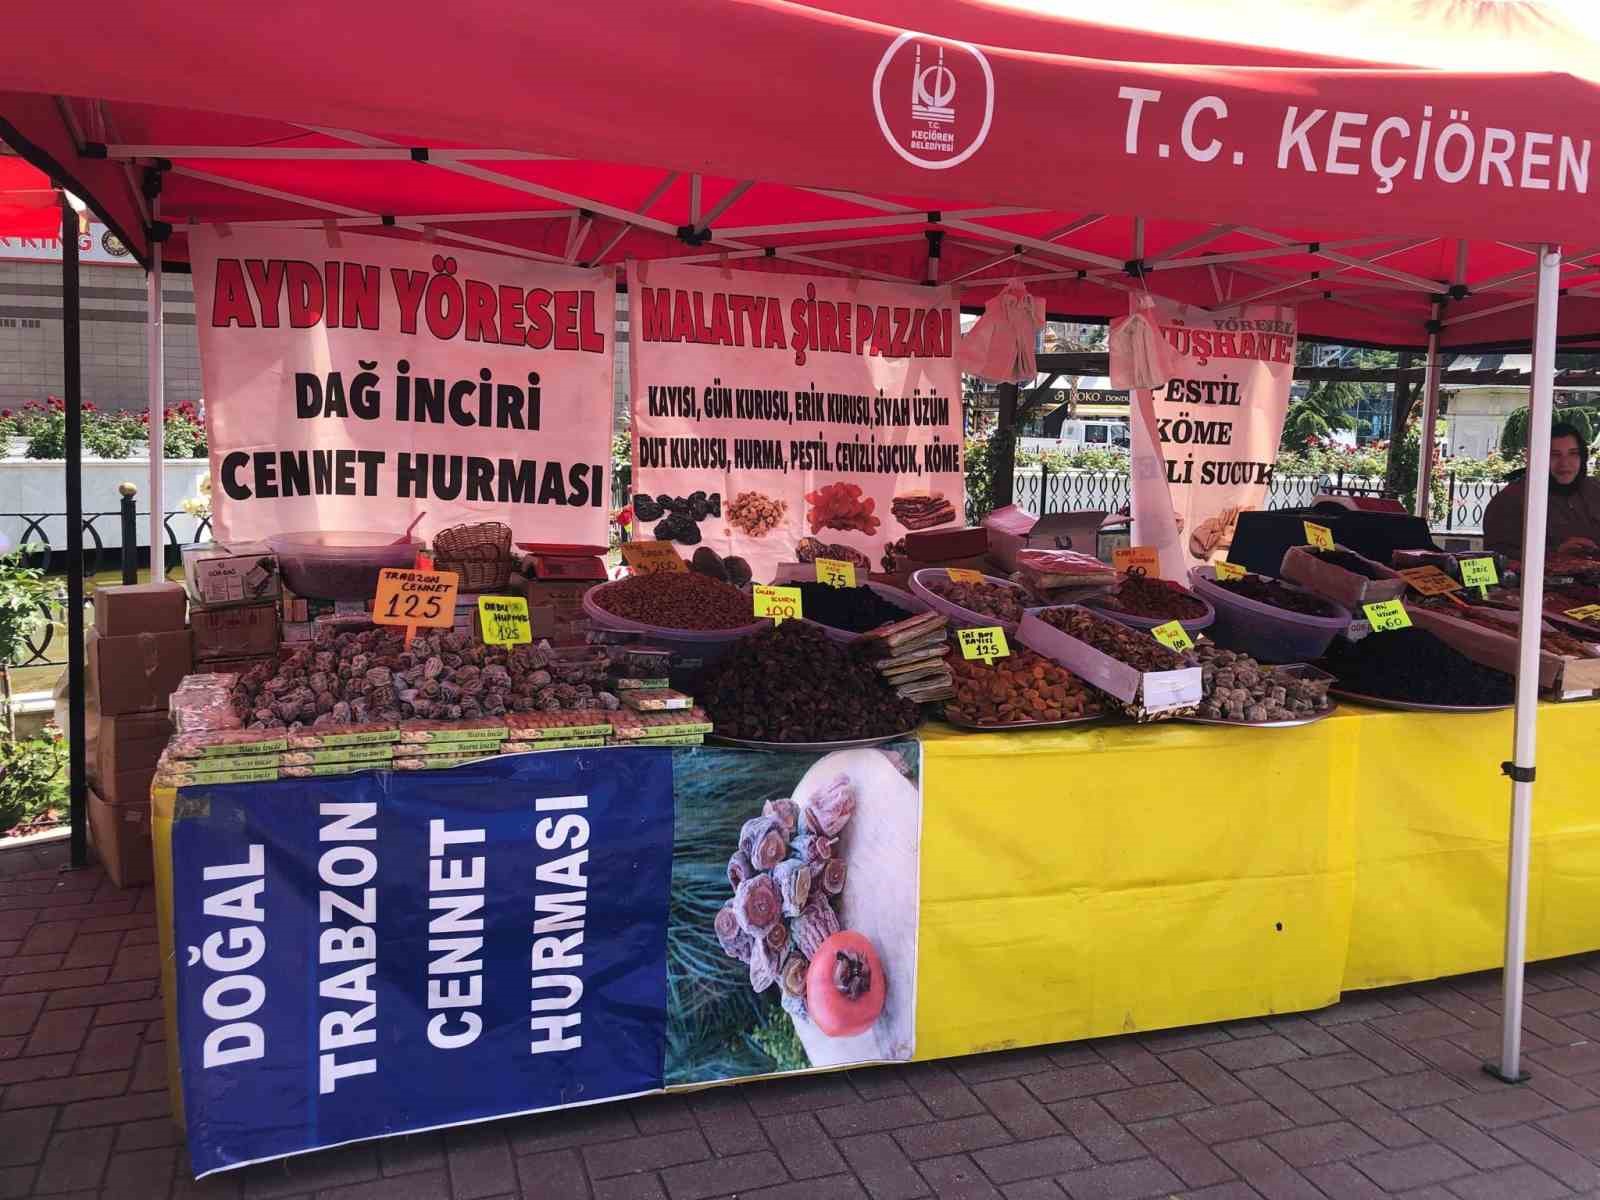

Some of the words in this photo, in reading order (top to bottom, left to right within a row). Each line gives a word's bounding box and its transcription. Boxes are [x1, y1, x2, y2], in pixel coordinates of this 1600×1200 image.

[910, 141, 954, 152] BELEDİYESİ
[911, 129, 954, 142] KEÇİÖREN
[1118, 86, 1245, 166] T.C.
[1277, 105, 1591, 194] KEÇİÖREN
[212, 258, 380, 330] AYDIN
[391, 254, 605, 354] YÖRESEL
[641, 287, 788, 349] MALATYA
[791, 282, 852, 366] ŞİRE
[856, 306, 953, 358] PAZARI
[1158, 319, 1294, 366] ÜŞHANE
[295, 359, 381, 420] DAĞ
[395, 359, 541, 431] İNCİRİ
[648, 386, 701, 422] KAYISI,
[703, 378, 733, 419] GÜN
[735, 388, 793, 425] KURUSU,
[795, 382, 825, 422] ERİK
[827, 394, 873, 429] KURUSU,
[874, 388, 911, 427] SİYAH
[913, 388, 949, 426] ÜZÜM
[1152, 374, 1242, 406] ESTİL
[1156, 411, 1233, 445] KÖME
[639, 436, 667, 468] DUT
[670, 437, 732, 474] KURUSU,
[734, 438, 788, 474] HURMA,
[836, 432, 876, 474] CEVİZLİ
[877, 443, 922, 477] SUCUK,
[924, 436, 960, 473] KÖME
[1201, 460, 1275, 486] SUCUK
[221, 449, 386, 502] CENNET
[397, 452, 604, 508] HURMASI
[384, 571, 441, 583] TRABZON
[401, 582, 452, 593] CENNET
[384, 593, 442, 619] 125
[765, 605, 795, 617] 100
[499, 628, 520, 641] 125
[976, 644, 1000, 656] 125
[427, 818, 486, 1050] CENNET
[530, 795, 590, 1055] HURMASI
[186, 843, 267, 1069] DOĞAL
[318, 802, 378, 1095] TRABZON
